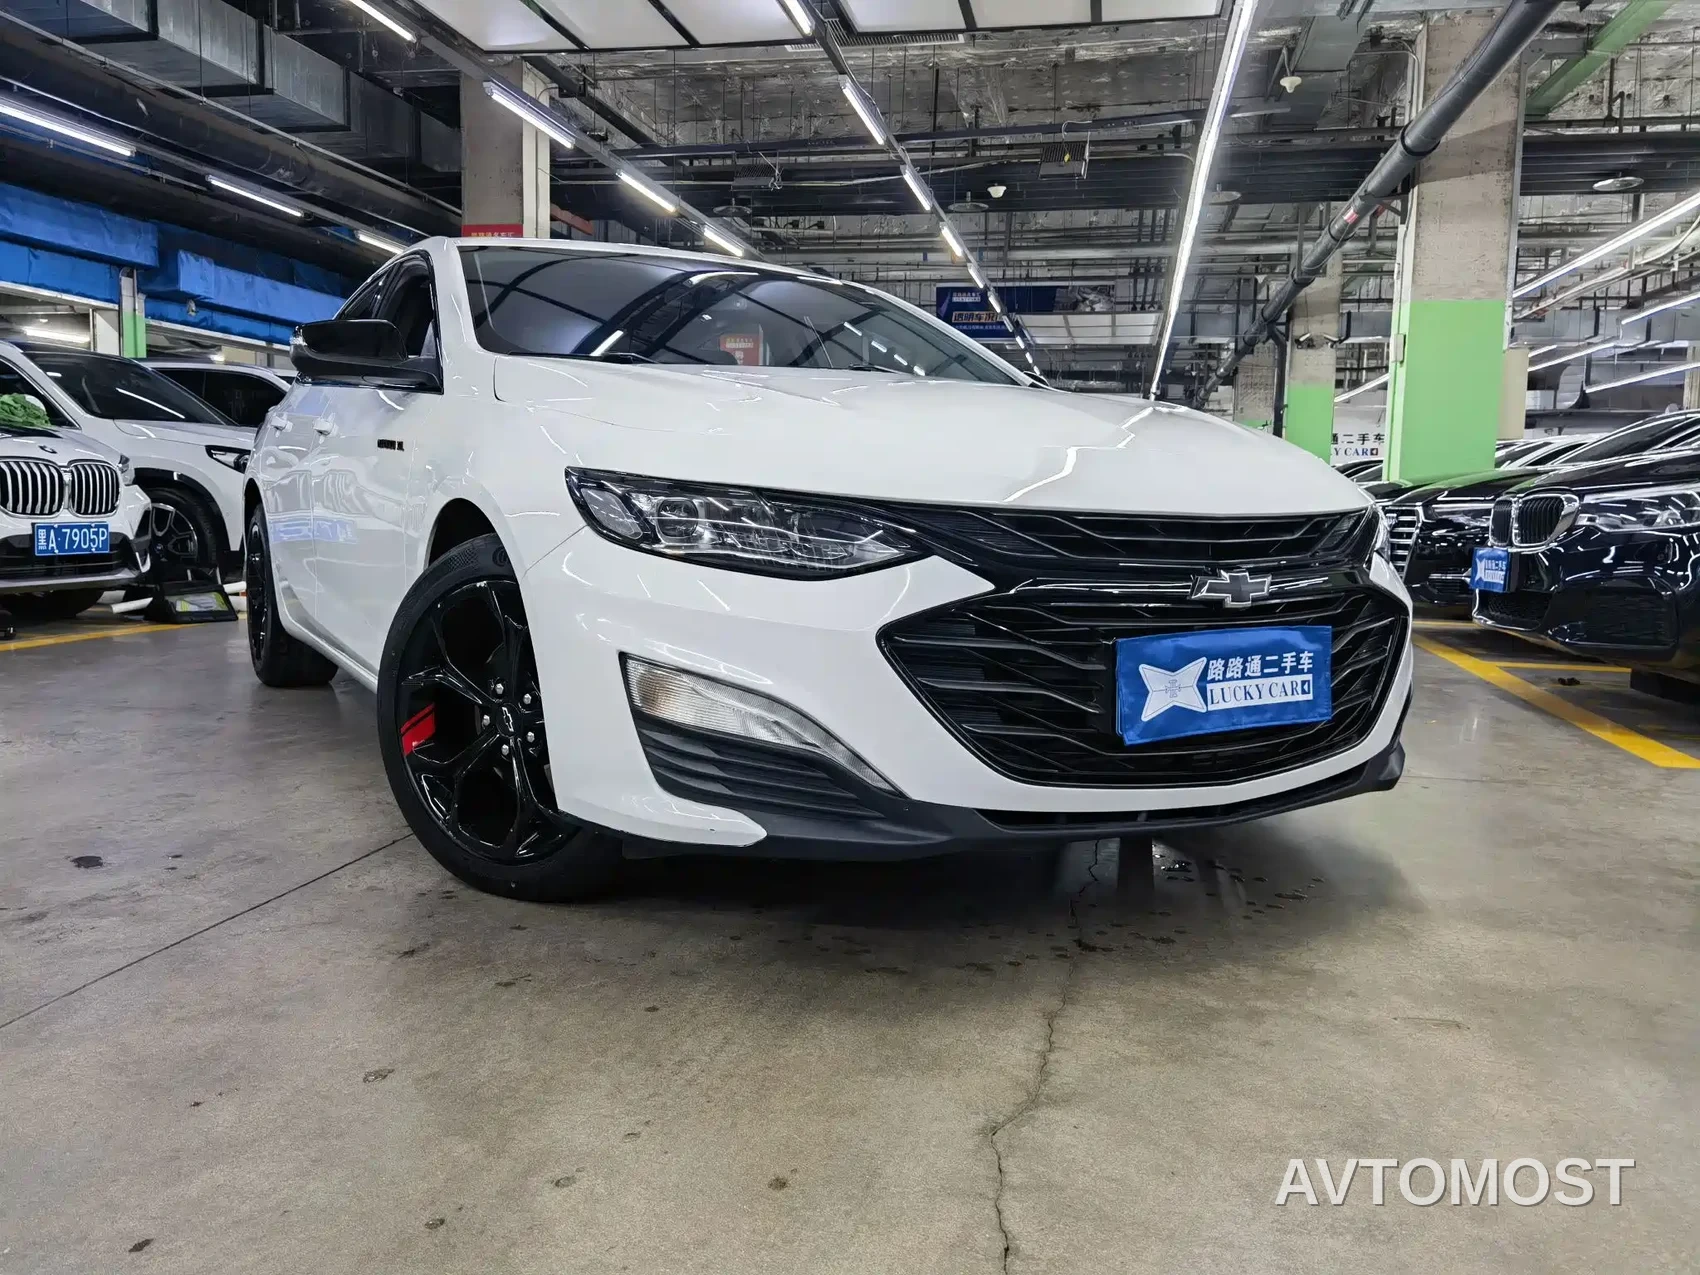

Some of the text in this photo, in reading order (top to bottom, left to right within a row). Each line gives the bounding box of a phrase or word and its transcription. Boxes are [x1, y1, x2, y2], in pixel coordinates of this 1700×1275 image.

[1207, 651, 1314, 681] 路路通二手车
[1209, 680, 1299, 705] LUCKY CAR
